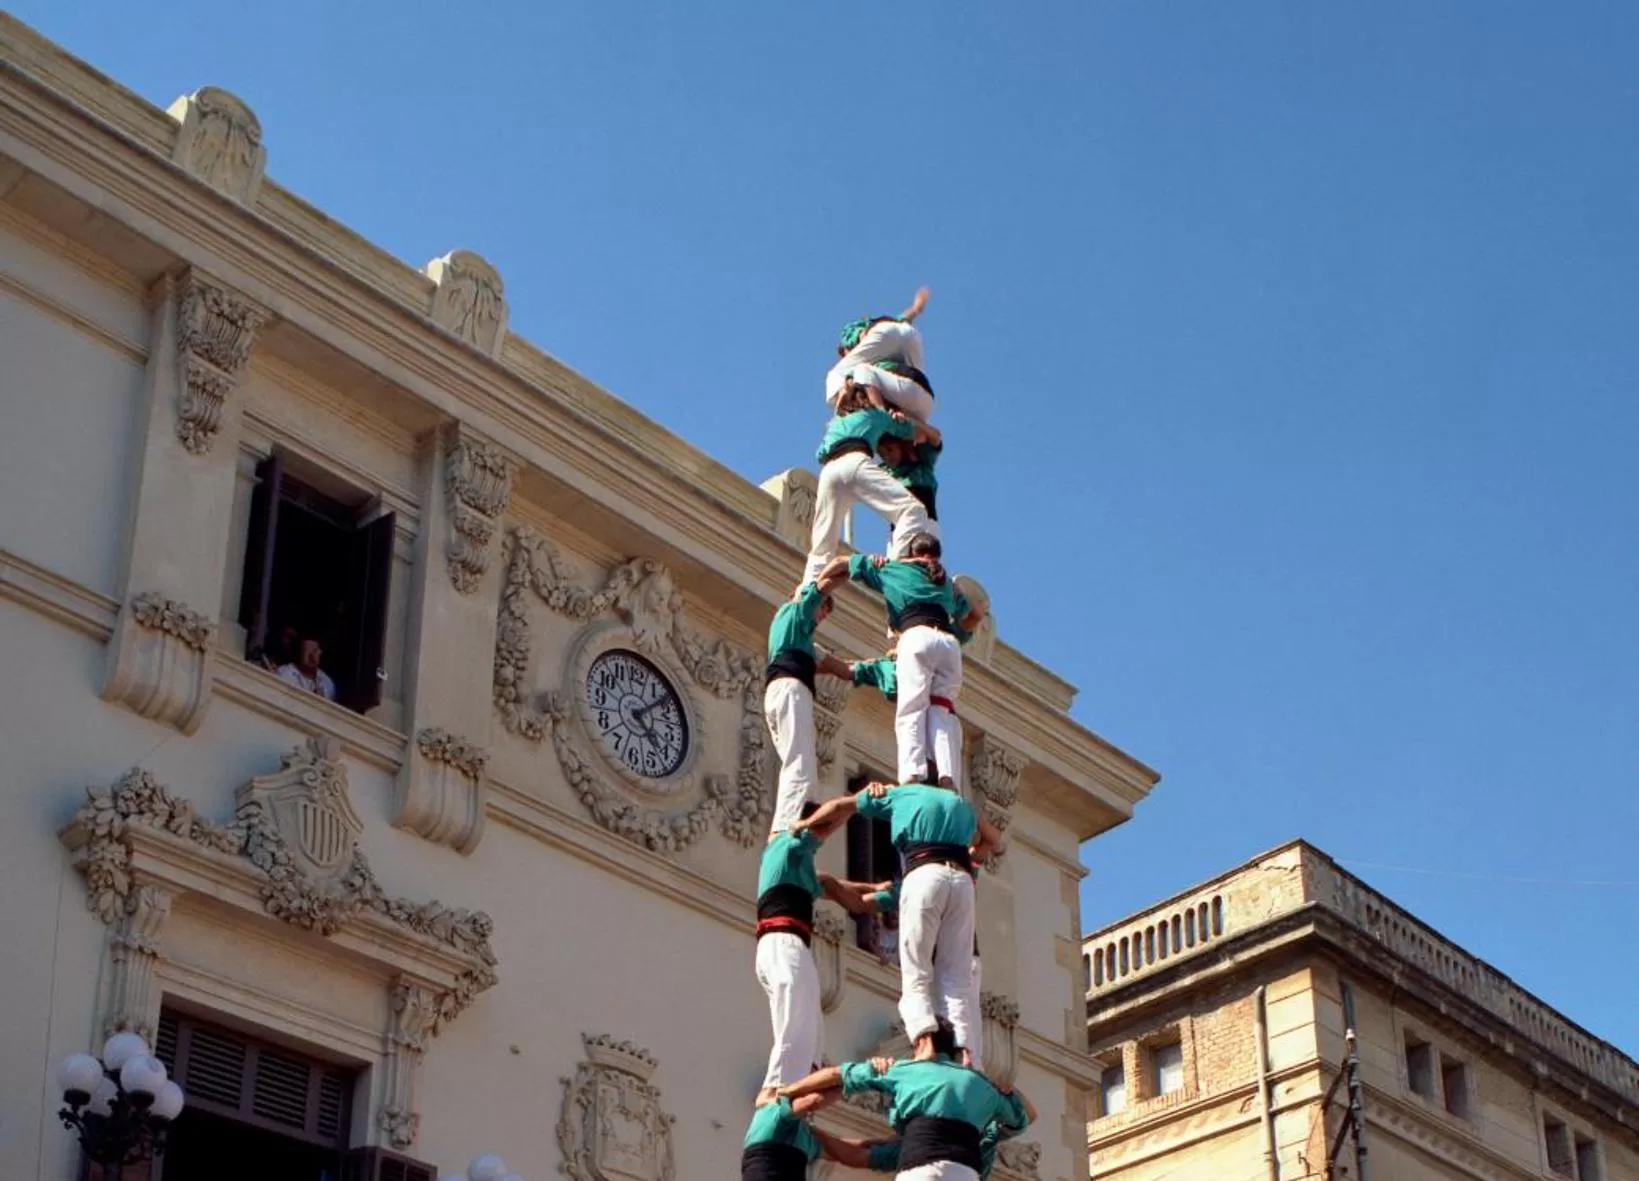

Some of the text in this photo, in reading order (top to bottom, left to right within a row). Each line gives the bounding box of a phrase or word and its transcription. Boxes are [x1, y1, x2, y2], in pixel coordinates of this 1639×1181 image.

[600, 670, 615, 690] 10
[614, 662, 624, 681] 11
[630, 665, 644, 686] 12
[595, 687, 606, 706] 9
[651, 682, 656, 699] 1
[598, 711, 609, 729] 8
[612, 732, 622, 750] 7
[628, 747, 639, 765] 6
[646, 750, 656, 768] 5
